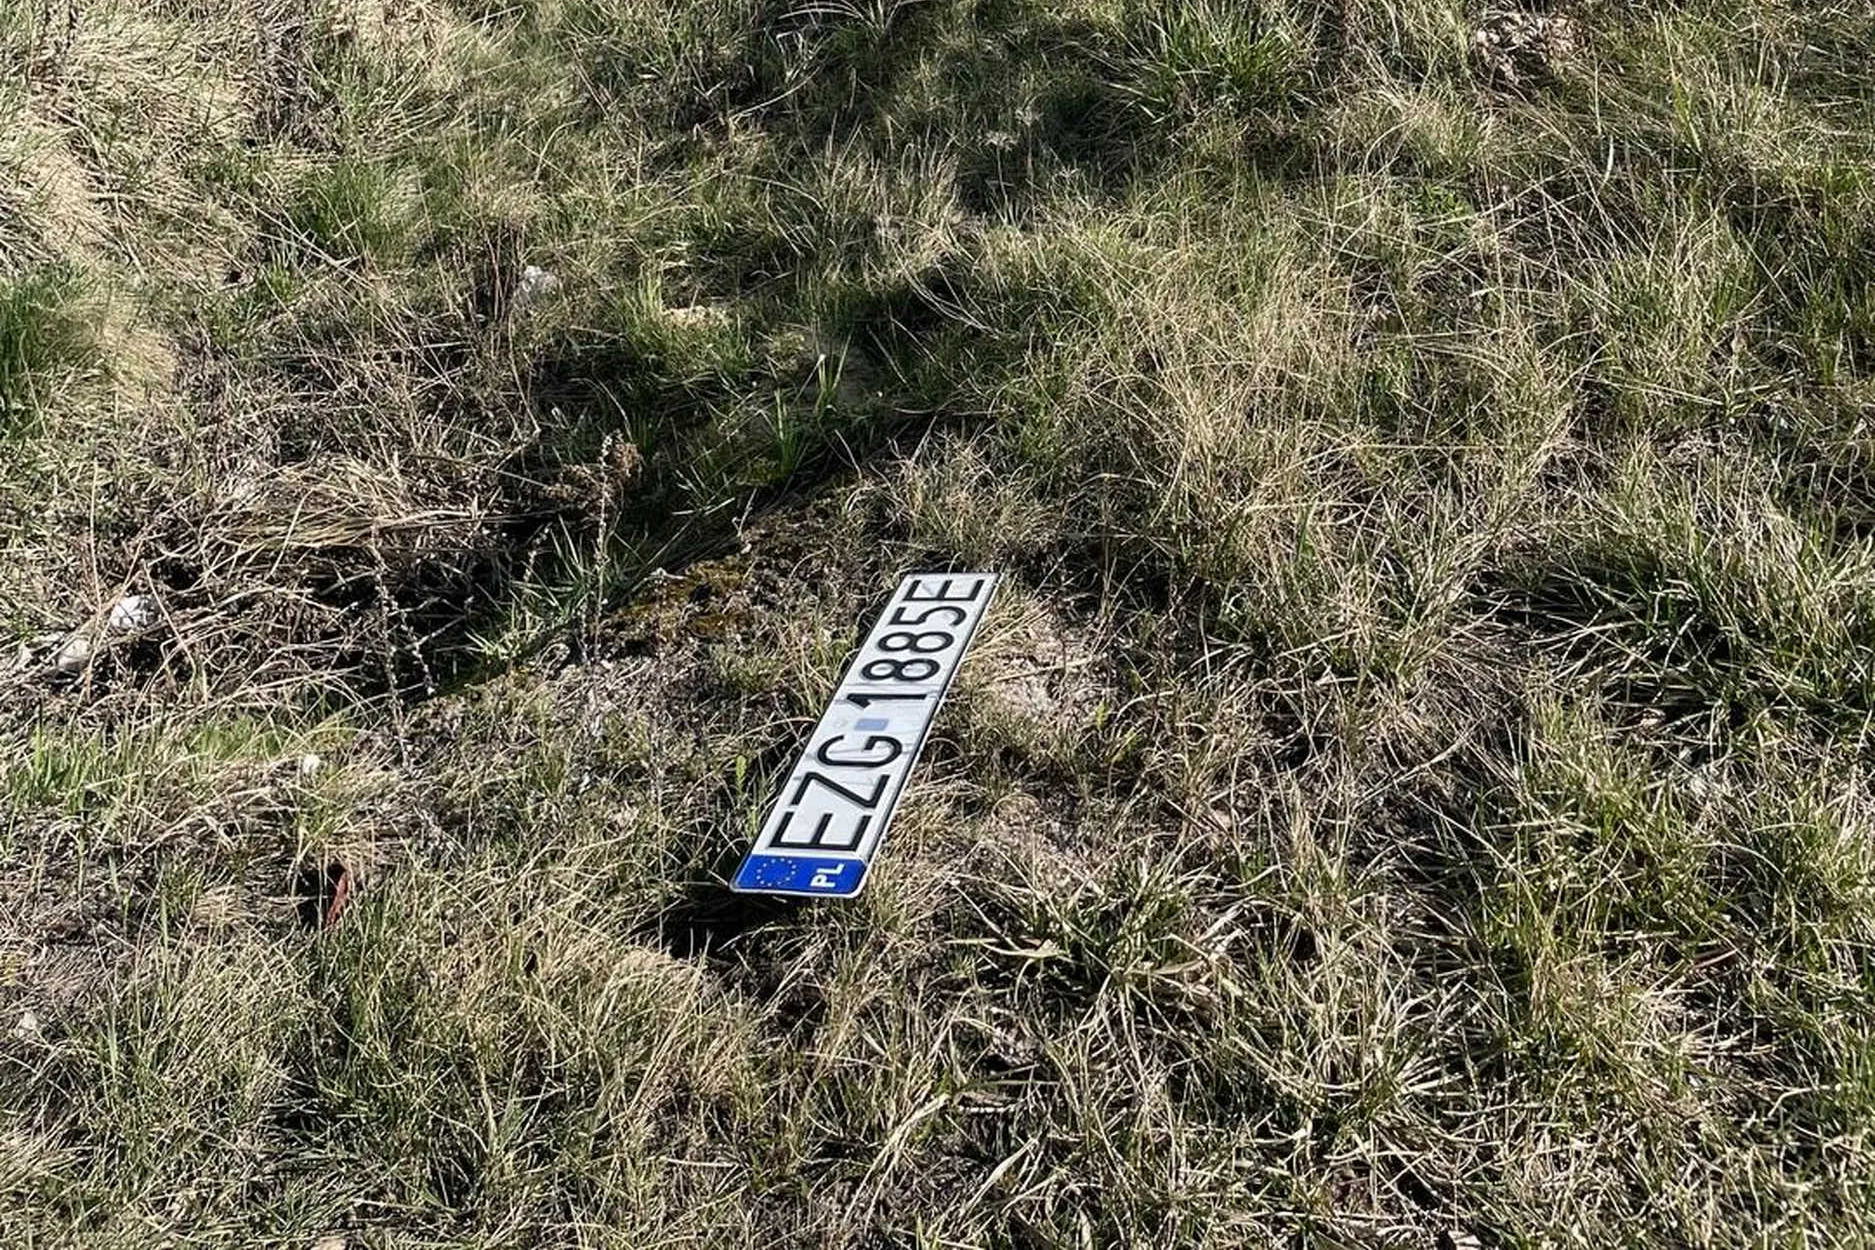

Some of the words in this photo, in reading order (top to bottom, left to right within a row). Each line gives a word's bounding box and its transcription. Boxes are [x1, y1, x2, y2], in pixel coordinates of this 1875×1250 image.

[769, 735, 903, 851] EZG
[847, 579, 985, 709] 1885E
[810, 862, 845, 888] PL
